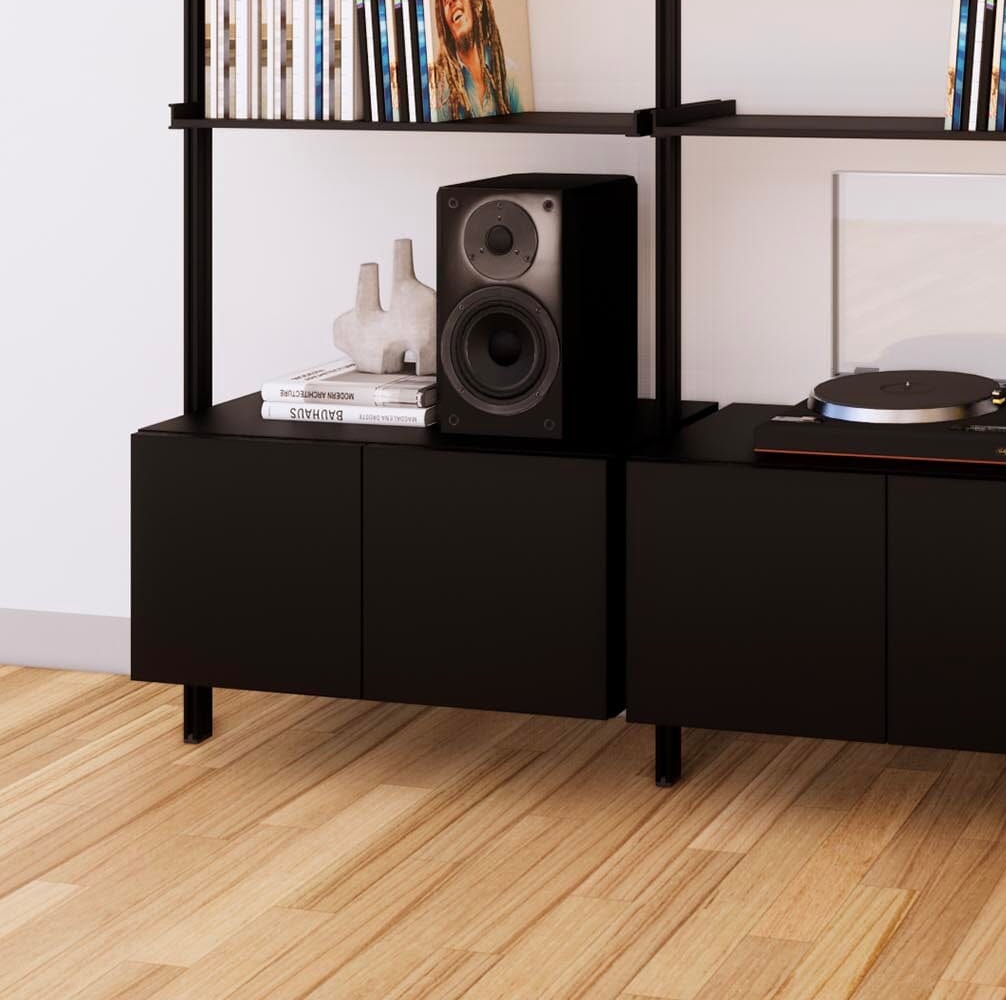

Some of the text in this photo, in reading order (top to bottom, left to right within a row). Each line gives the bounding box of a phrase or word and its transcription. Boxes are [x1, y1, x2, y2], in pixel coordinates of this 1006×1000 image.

[279, 389, 354, 401] MODERN ARCHITECTURE
[289, 407, 343, 421] BAUHAUS
